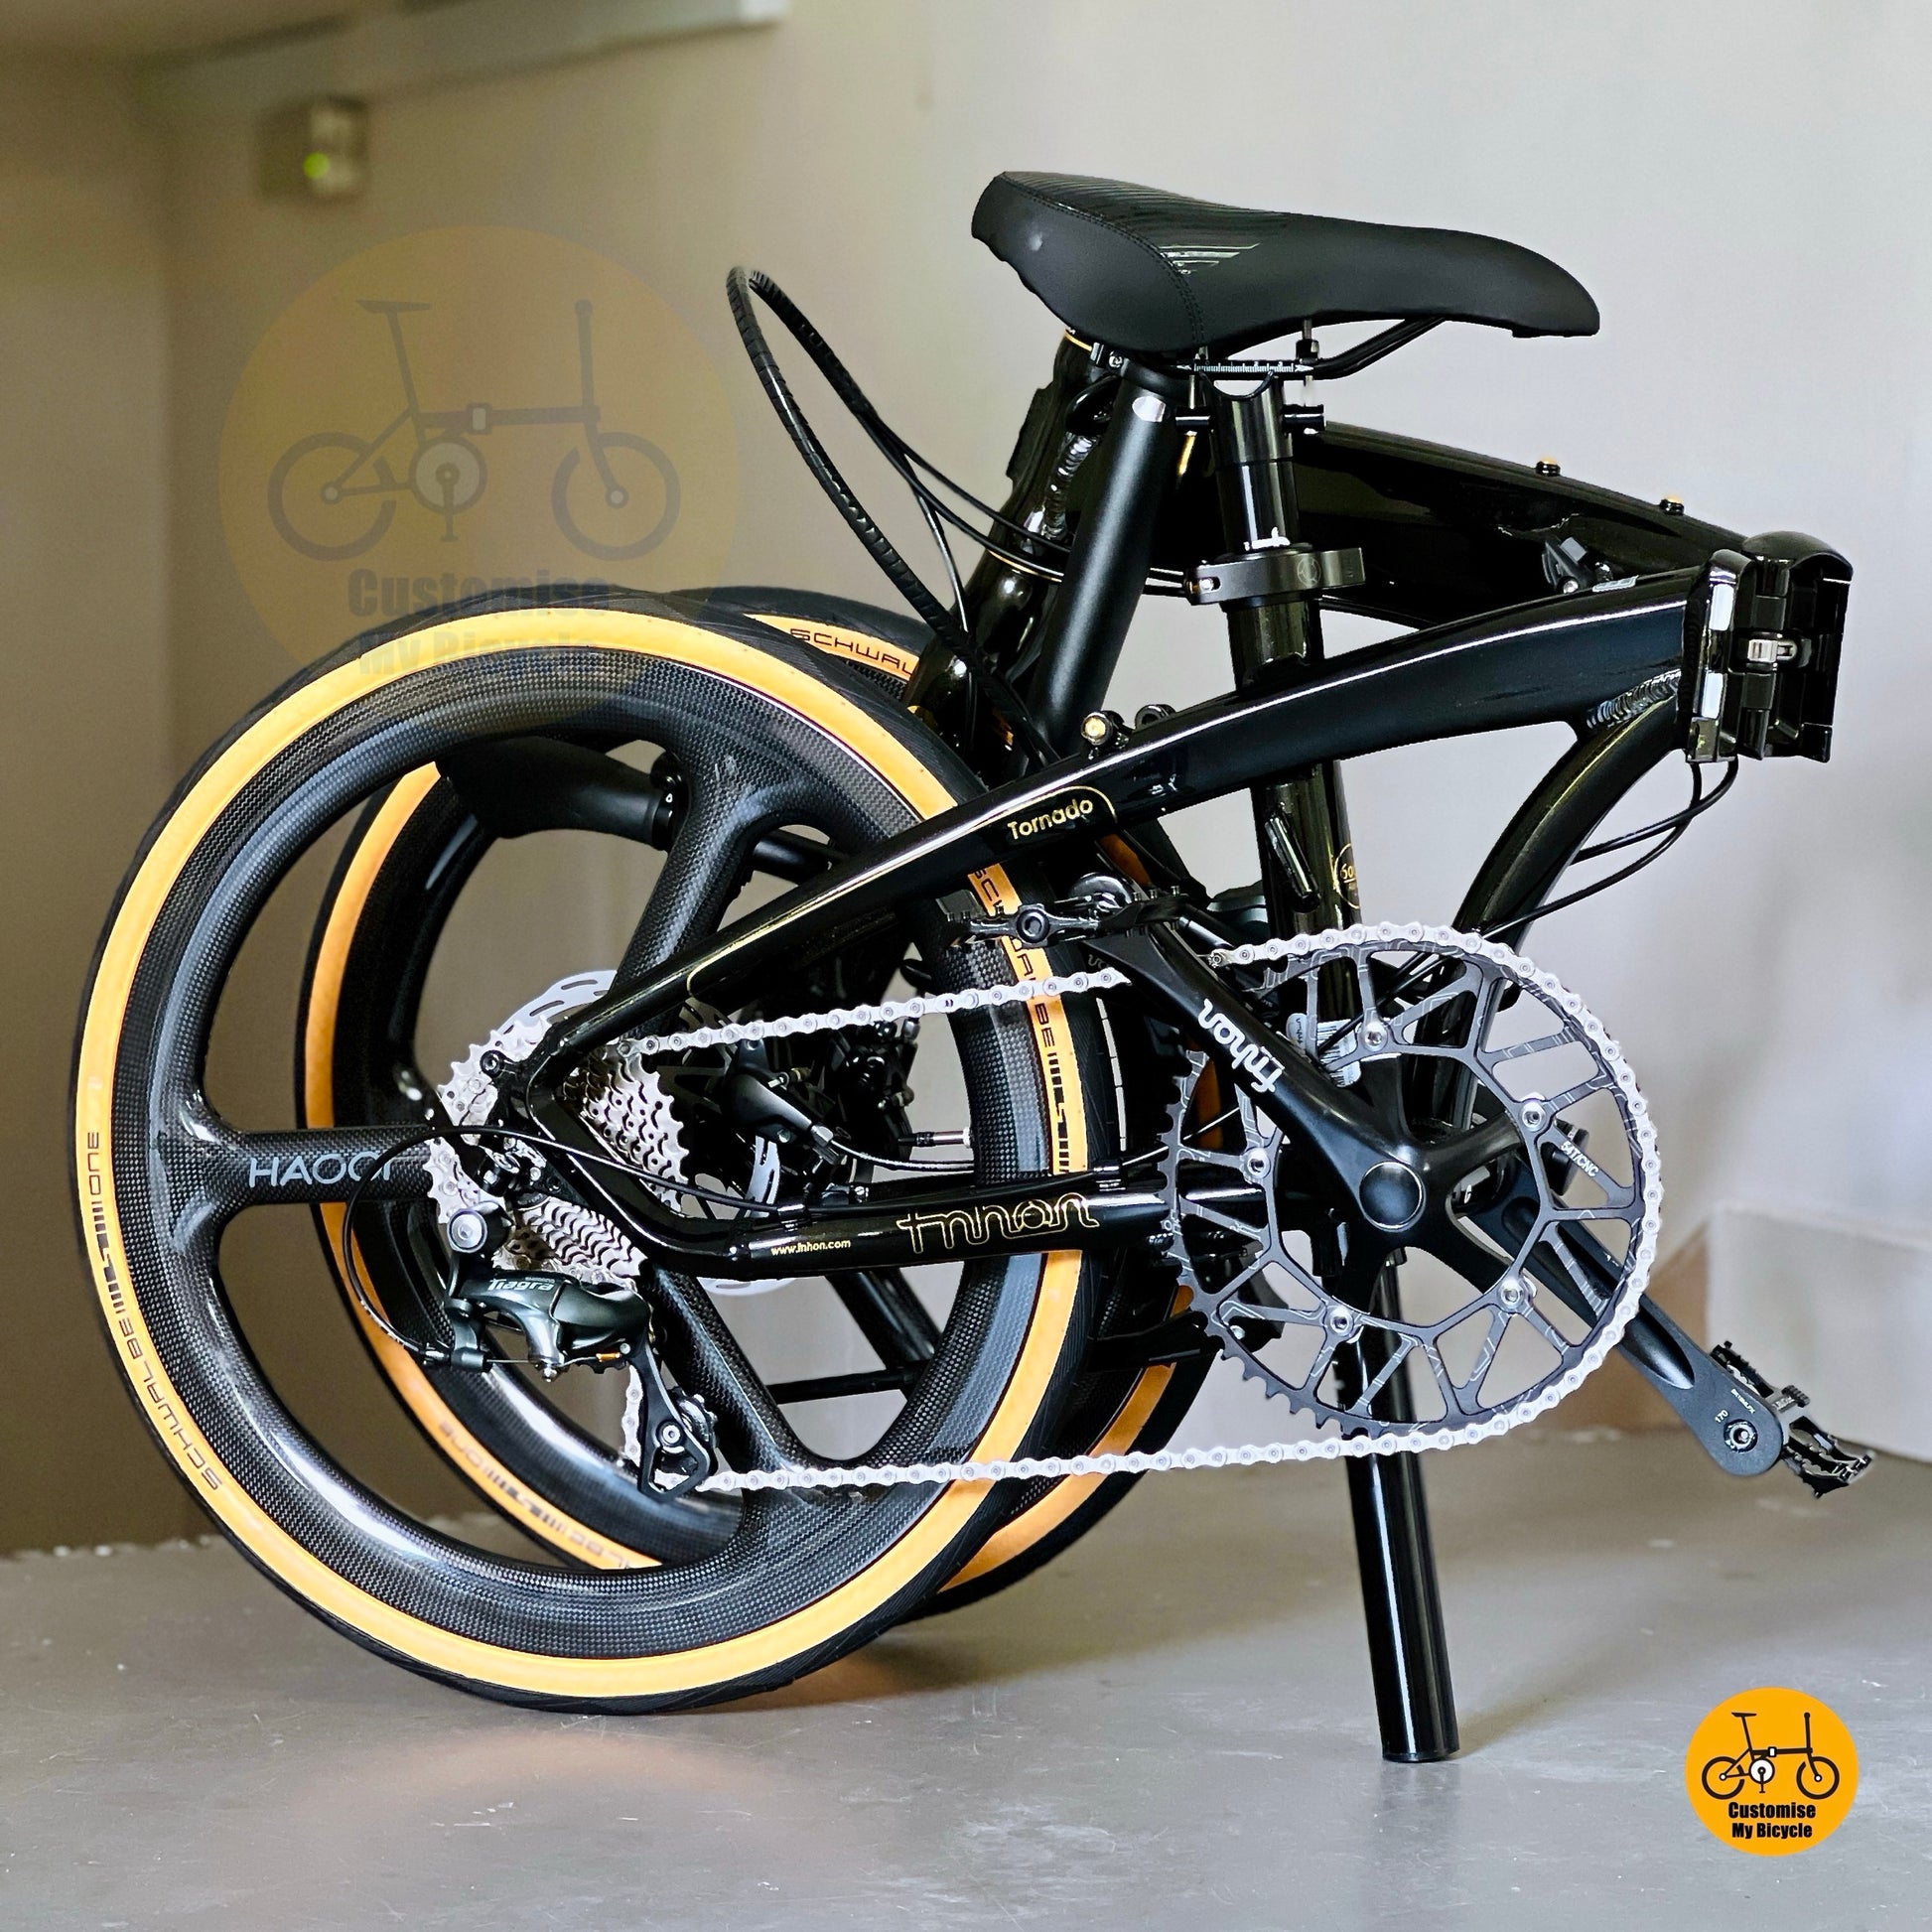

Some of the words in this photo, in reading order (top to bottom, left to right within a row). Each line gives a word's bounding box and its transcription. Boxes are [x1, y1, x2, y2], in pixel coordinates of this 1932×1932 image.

[1007, 798, 1094, 840] Tornado
[86, 1131, 101, 1195] ONE
[487, 1278, 555, 1292] Tiagra
[118, 1318, 222, 1491] SCHWALBE
